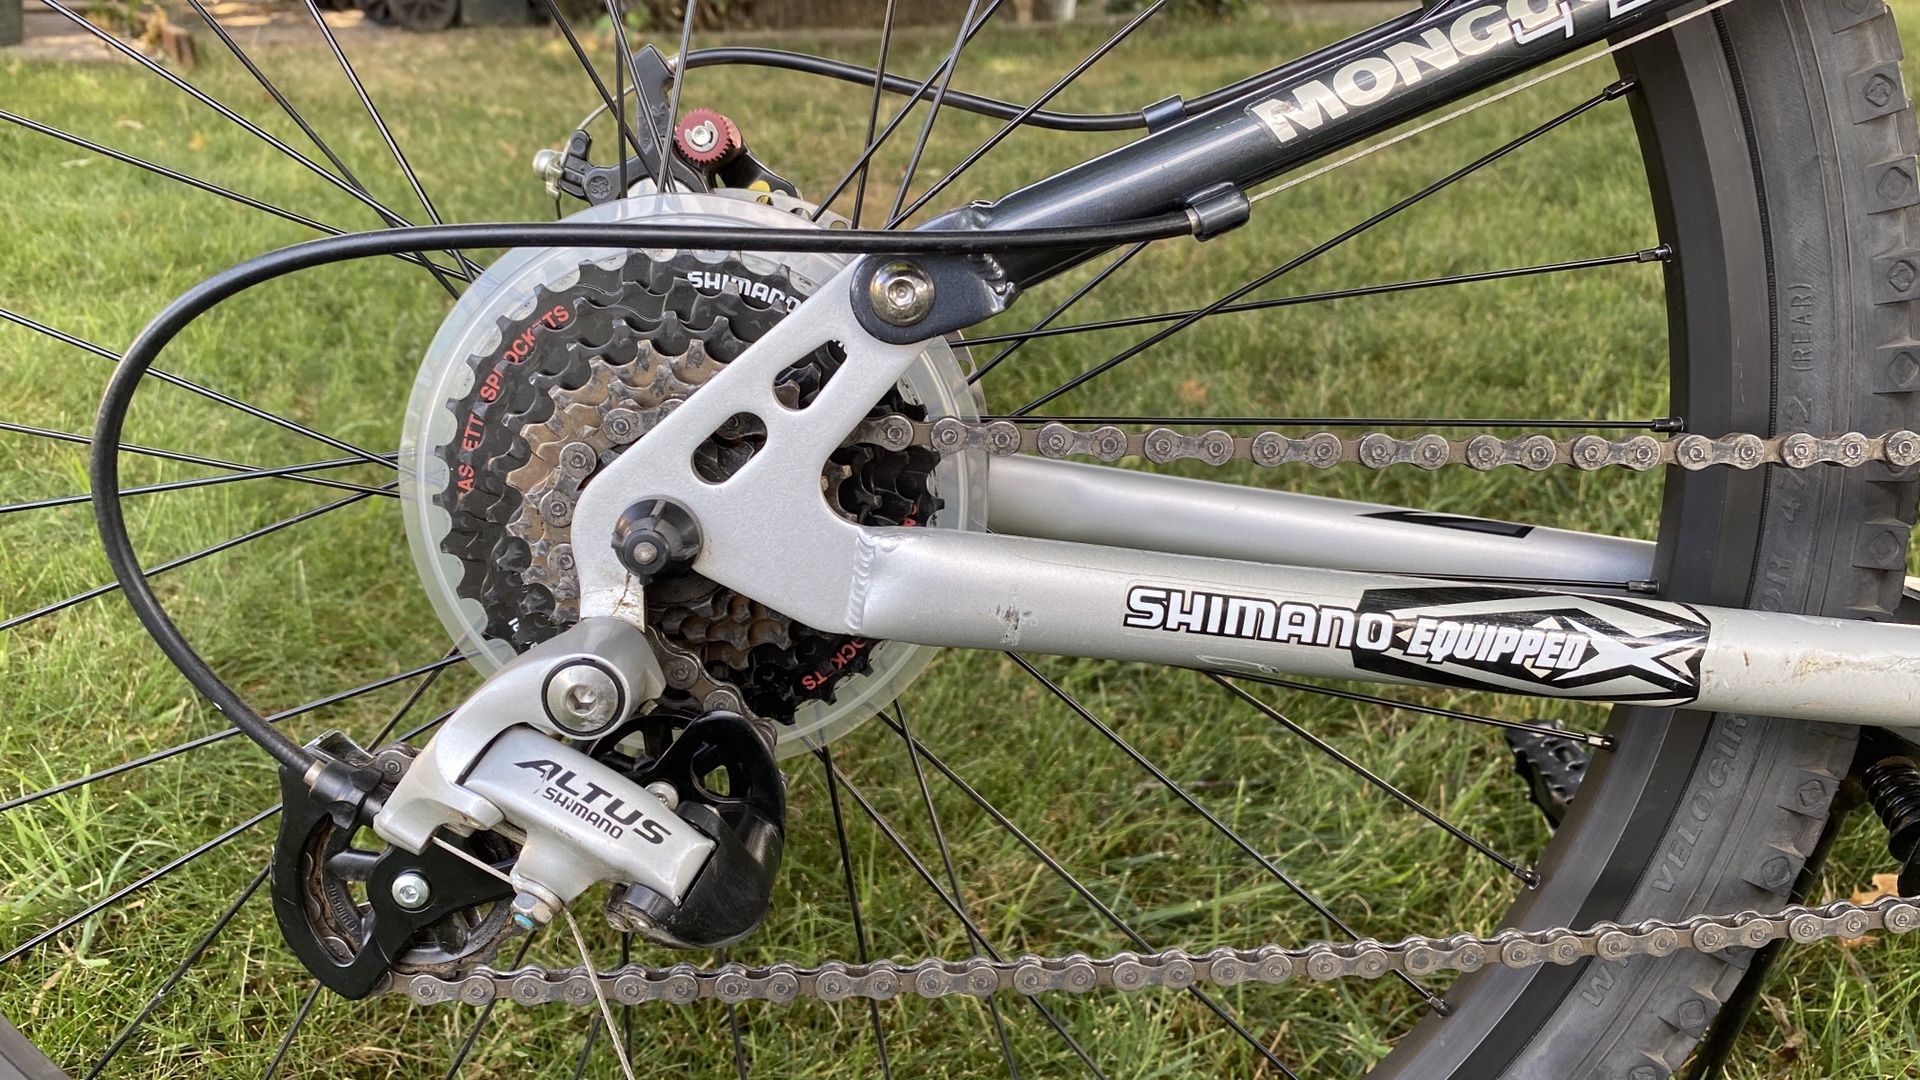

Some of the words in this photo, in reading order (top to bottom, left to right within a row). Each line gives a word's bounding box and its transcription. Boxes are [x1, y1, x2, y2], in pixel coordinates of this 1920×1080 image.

[1788, 284, 1813, 371] (REAR)
[1125, 587, 1394, 653] SHIMANO
[1410, 616, 1591, 669] EQUIPPED
[514, 759, 672, 845] ALTUS
[542, 786, 624, 841] SHIMANO
